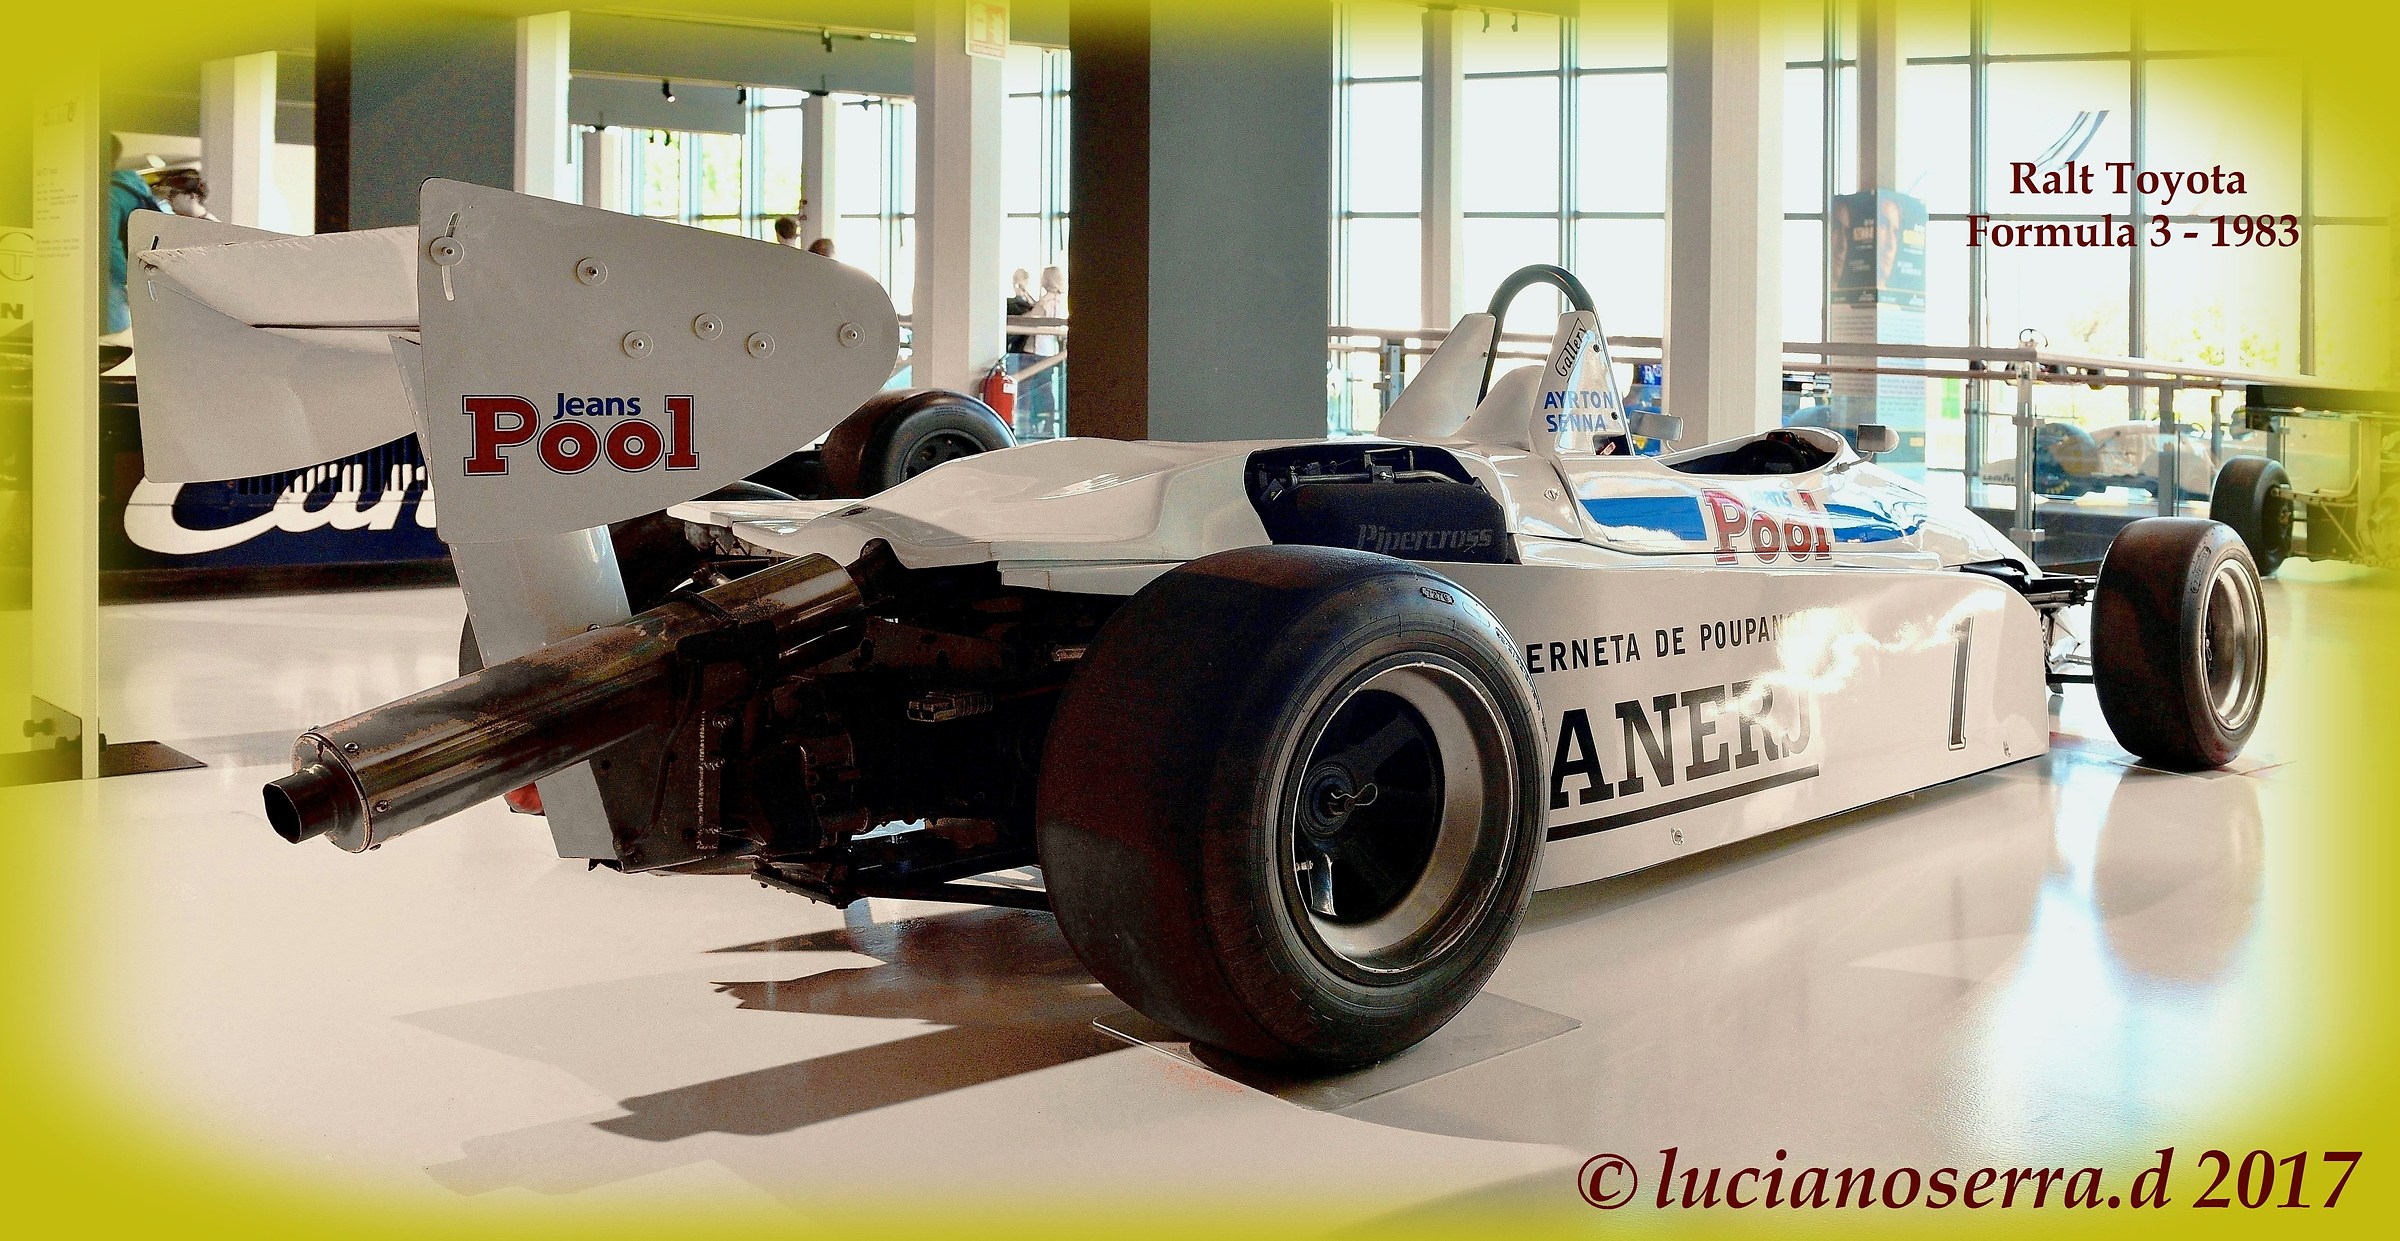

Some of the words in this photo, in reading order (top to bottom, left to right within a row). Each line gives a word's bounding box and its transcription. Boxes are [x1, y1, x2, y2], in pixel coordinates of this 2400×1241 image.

[552, 392, 642, 421] Jeans
[1543, 390, 1614, 410] AYRTON
[461, 394, 700, 477] Pool
[1545, 413, 1607, 433] SENNA
[1357, 523, 1494, 555] Pipercross
[1700, 487, 1834, 566] Pool
[1655, 626, 1686, 658] DE
[1947, 615, 1975, 752] 1
